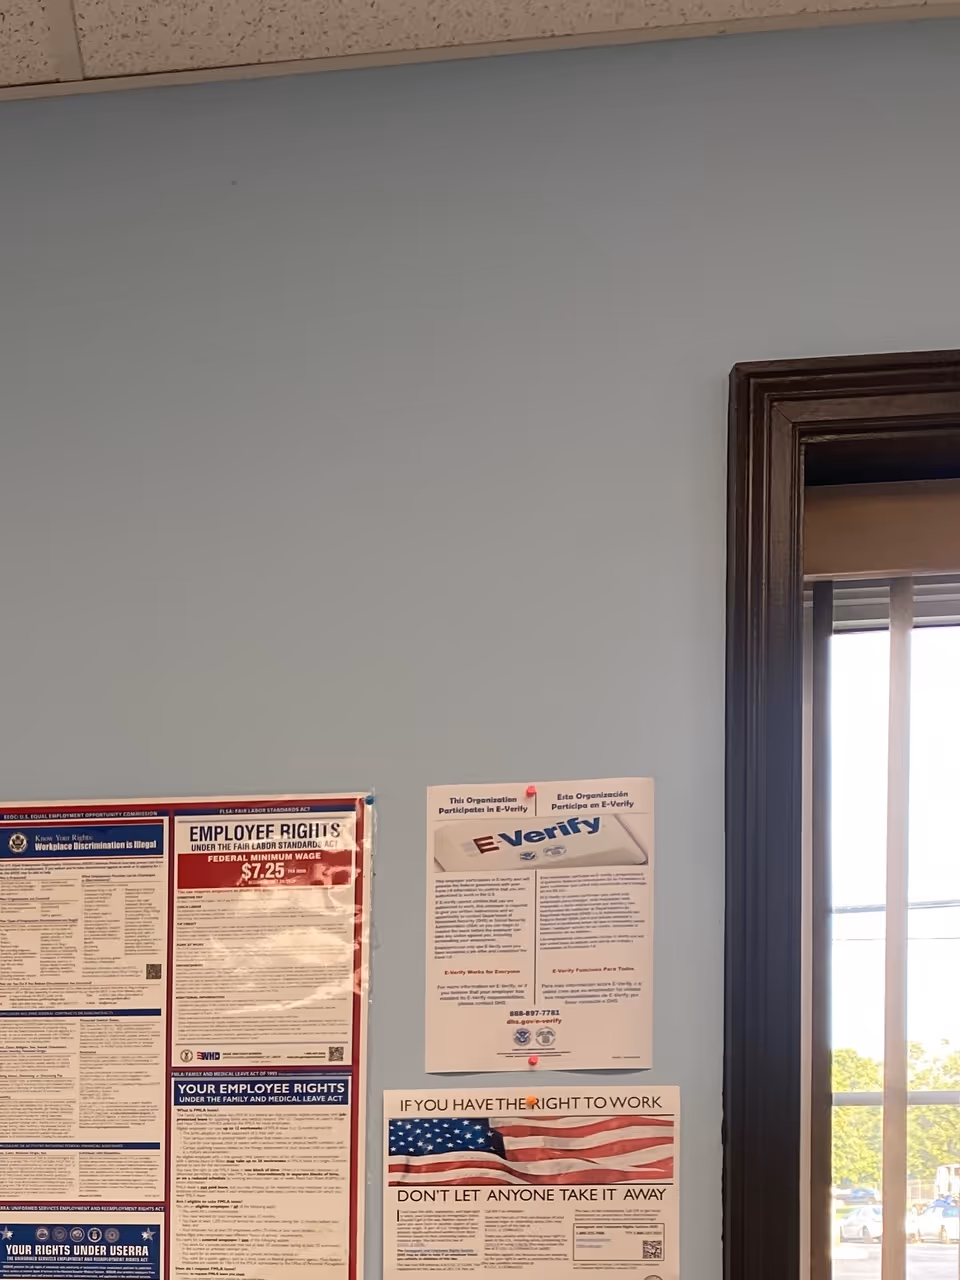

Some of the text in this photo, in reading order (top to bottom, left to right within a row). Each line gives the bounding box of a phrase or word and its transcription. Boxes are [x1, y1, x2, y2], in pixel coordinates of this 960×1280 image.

[466, 796, 517, 804] Organization
[573, 791, 628, 800] Organización
[551, 803, 587, 811] Participa
[602, 800, 634, 809] E-Verify
[190, 823, 340, 842] EMPLOYEE RIGHTS
[473, 817, 600, 854] E-Verify
[35, 843, 73, 851] Workplace
[74, 842, 125, 850] Discrimination
[134, 841, 156, 849] Illegal
[278, 841, 321, 849] STANDARDS
[241, 862, 284, 880] $7.25
[201, 1052, 220, 1060] WHD
[178, 1083, 345, 1094] YOUR EMPLOYEE RIGHTS
[400, 1096, 662, 1111] IF YOU HAVE THE RIGHT TO WORK
[398, 1188, 666, 1202] DON'T LET ANYONE TAKE IT AWAY
[6, 1245, 149, 1256] YOUR RIGHTS UNDER USERRA
